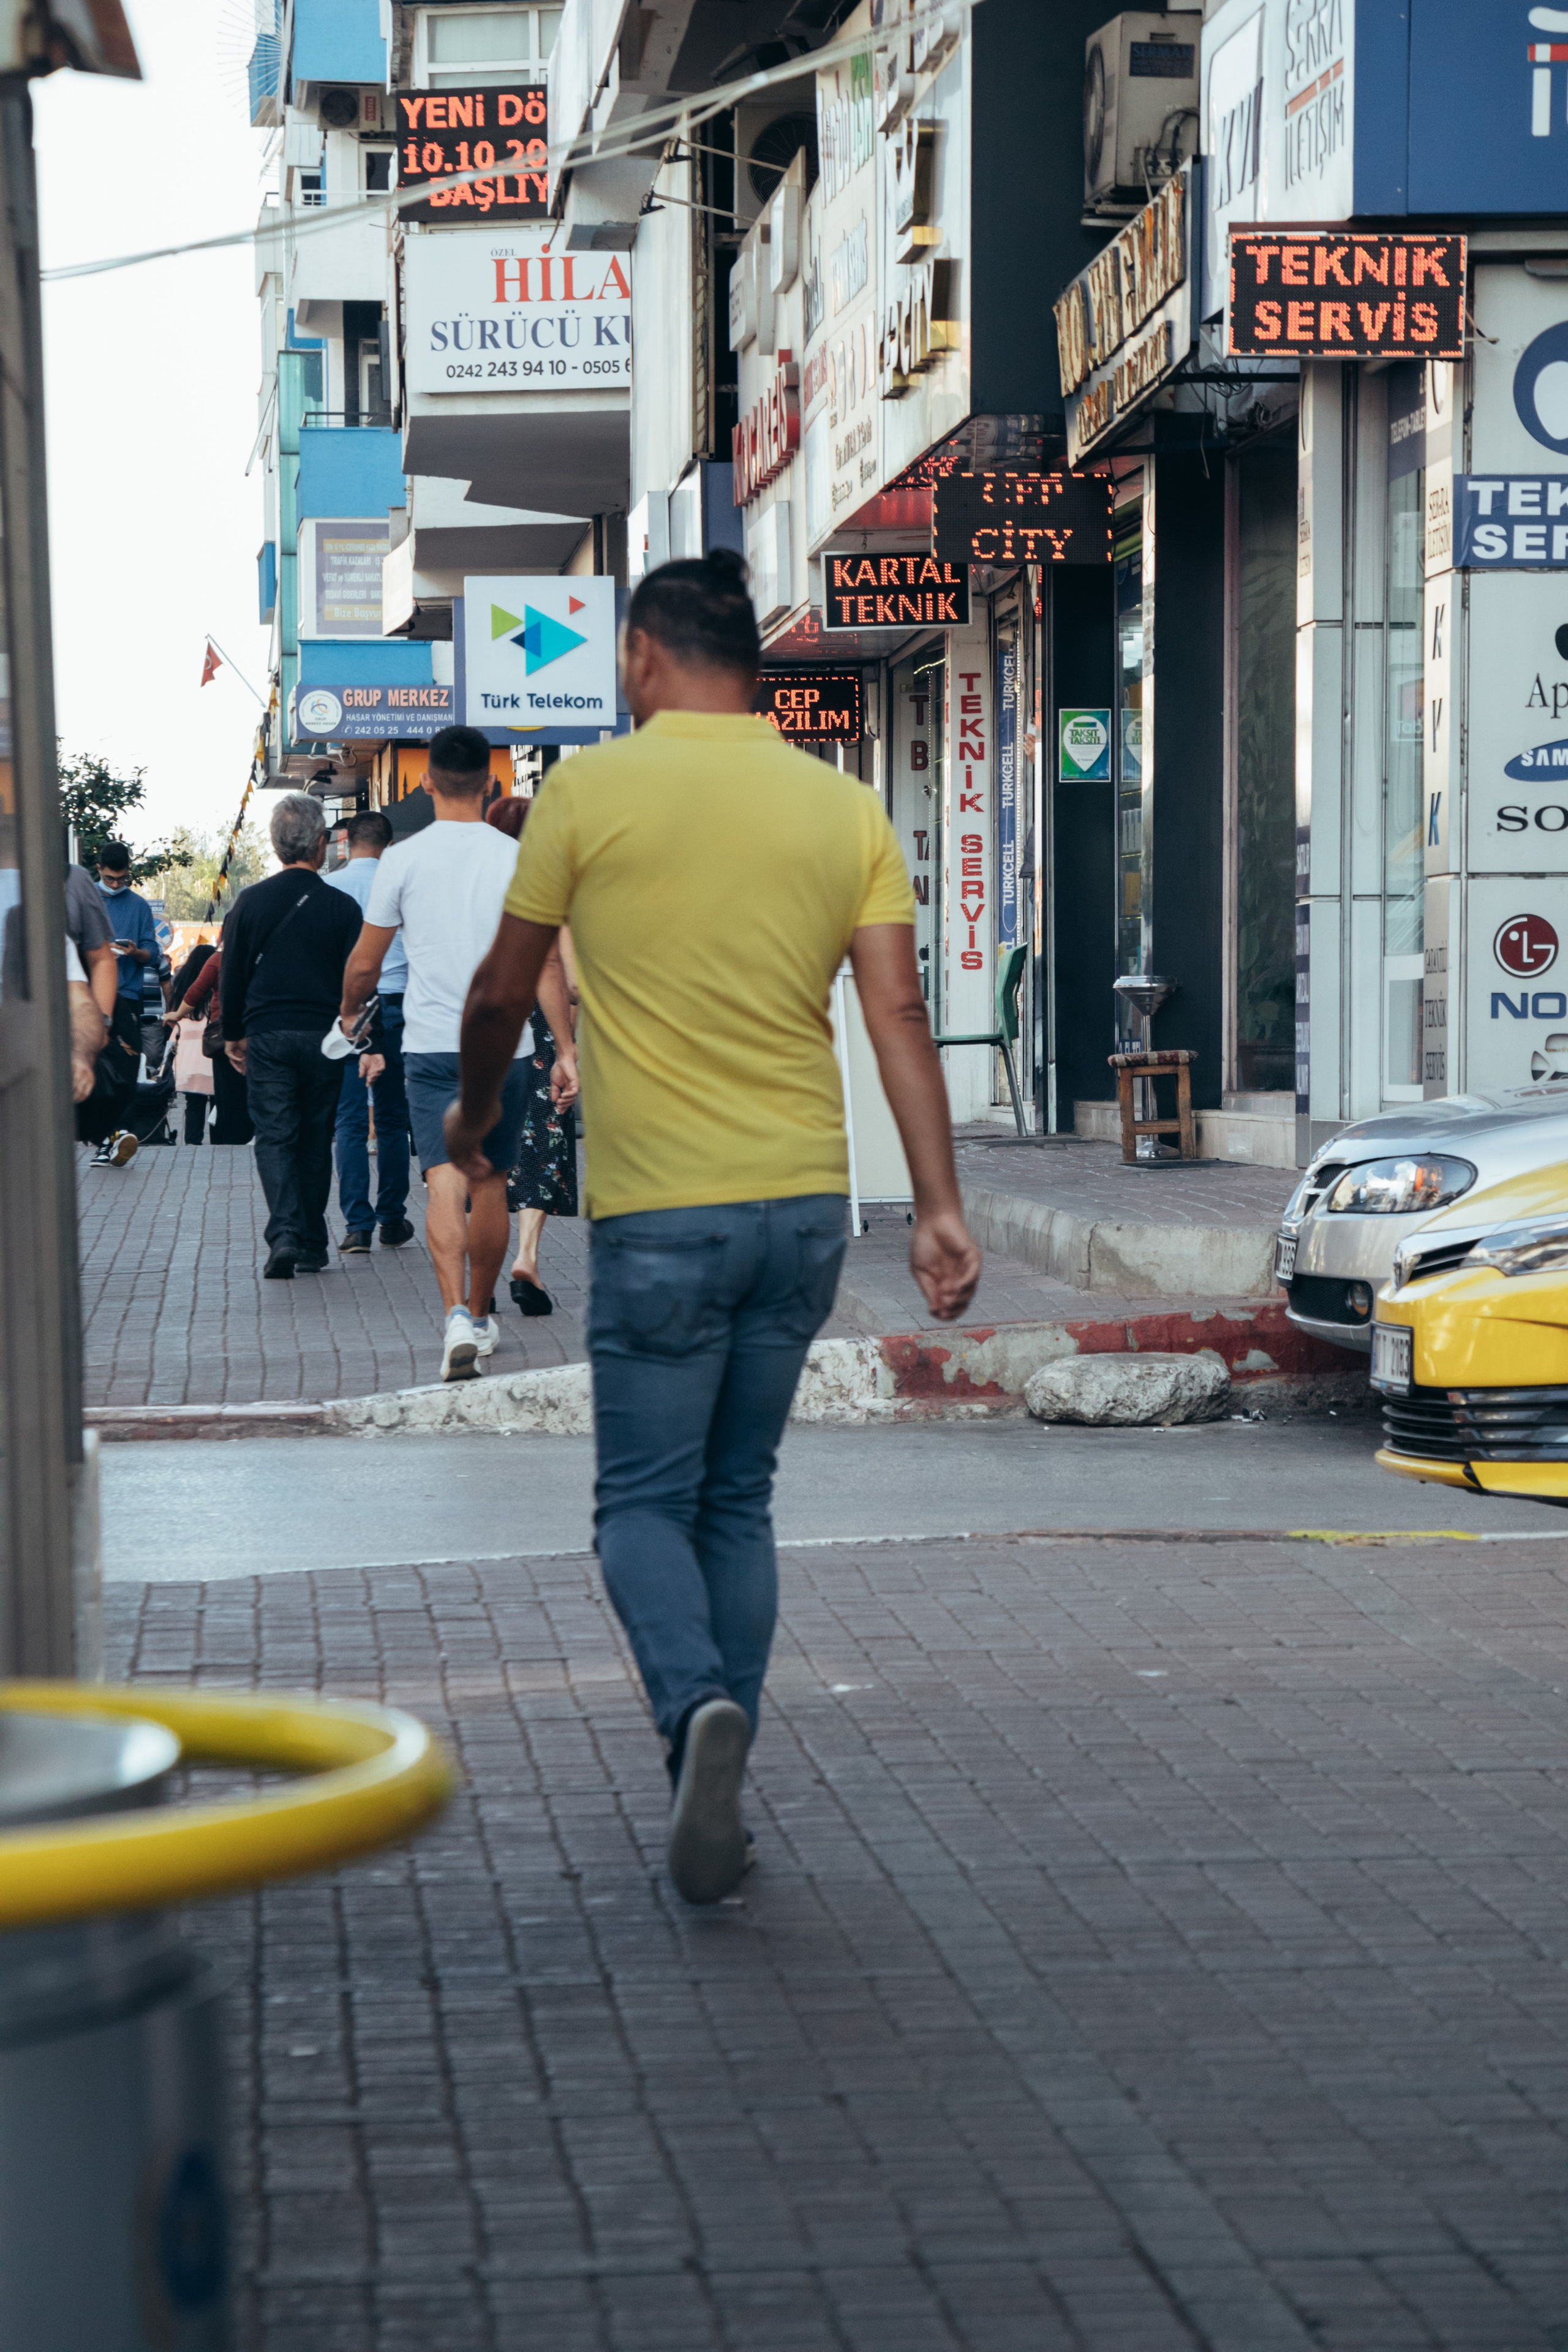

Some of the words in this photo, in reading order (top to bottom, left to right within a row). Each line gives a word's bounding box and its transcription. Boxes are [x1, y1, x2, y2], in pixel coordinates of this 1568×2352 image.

[491, 247, 518, 257] ÖZEL
[1254, 290, 1439, 342] SERVİS
[431, 309, 582, 352] SÜRÜCÜ
[446, 364, 483, 379] 0242
[487, 361, 518, 377] 243
[522, 361, 544, 375] 94
[548, 360, 567, 375] 10
[582, 360, 620, 374] 0505
[834, 557, 961, 587] KARTAL
[334, 607, 352, 617] Bize
[835, 592, 959, 624] TEKNİK
[342, 689, 382, 707] GRUP
[388, 689, 449, 707] MERKEZ
[481, 693, 520, 709] Türk
[527, 693, 603, 709] Telekom
[775, 689, 820, 709] CEP
[372, 712, 404, 722] YÖNETİMİ
[417, 713, 453, 723] DANIŞMAN
[755, 710, 850, 730] AZILIM
[1002, 742, 1014, 809] TURKCELL
[1497, 805, 1568, 832] SO
[1002, 840, 1015, 907] TURKCELL
[1494, 916, 1558, 978] LG
[1490, 992, 1567, 1019] NO
